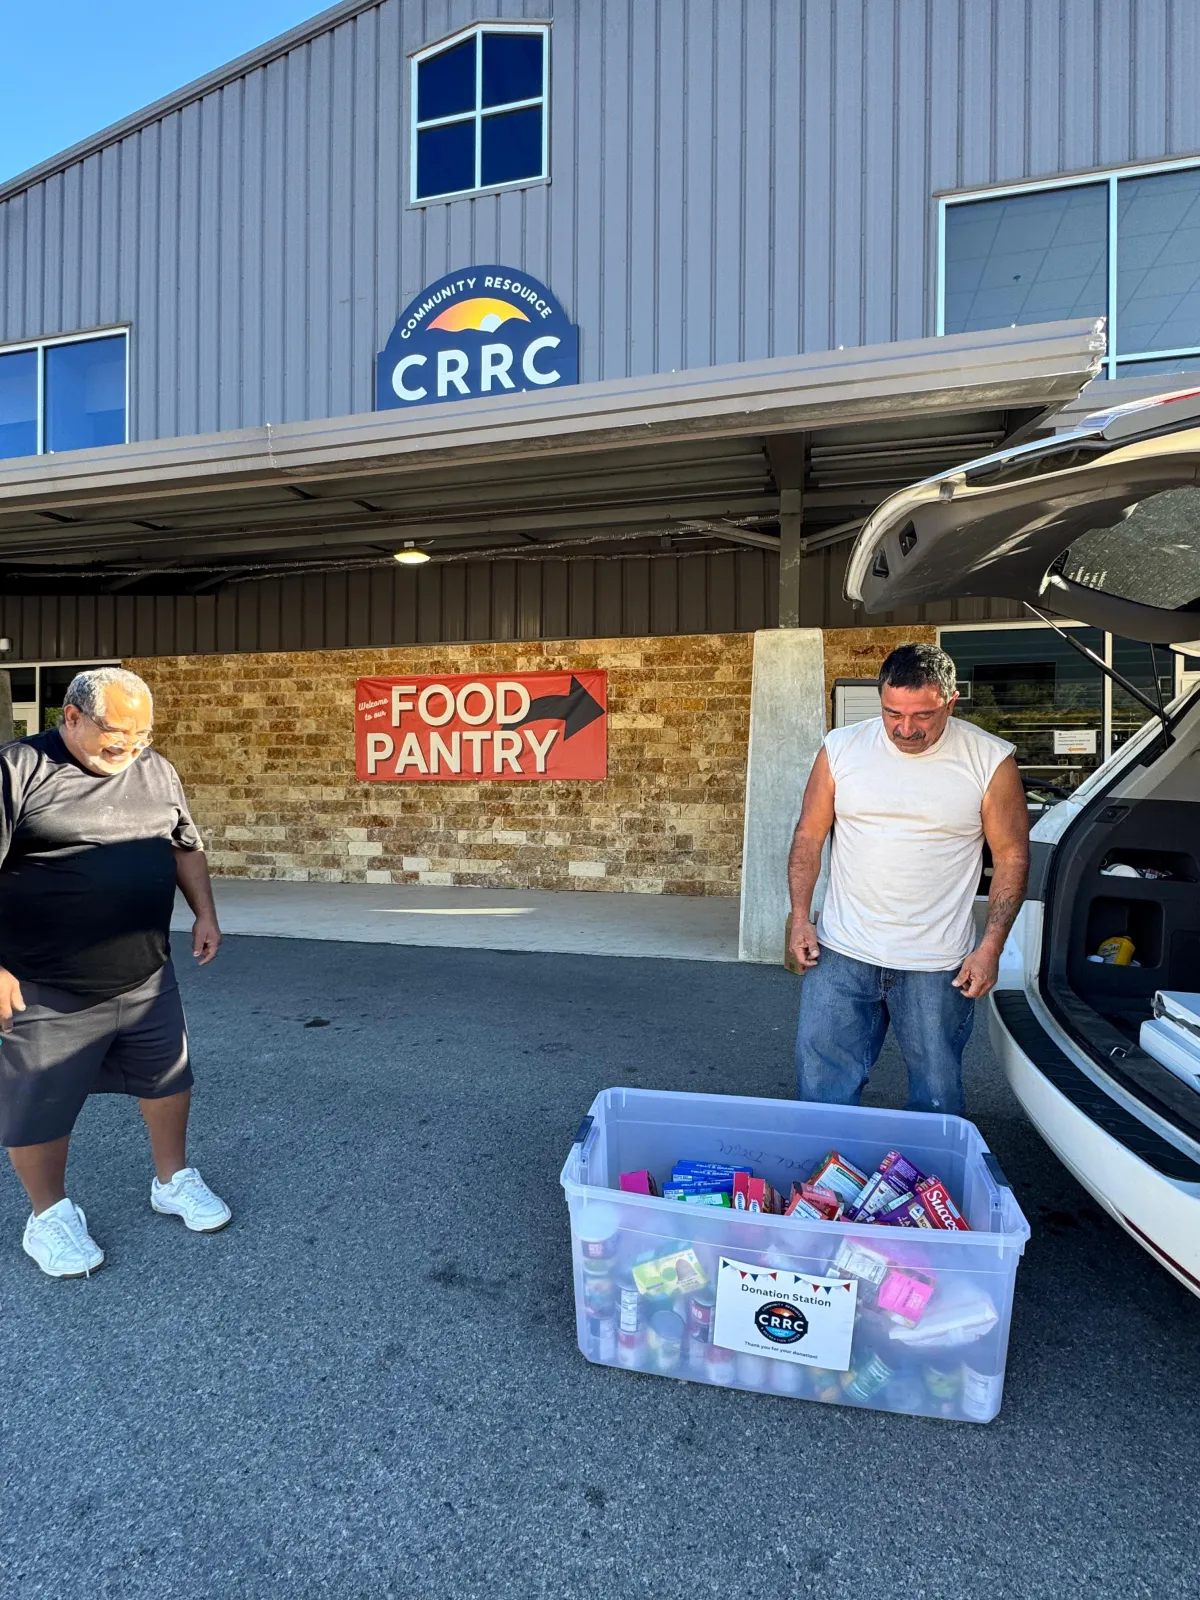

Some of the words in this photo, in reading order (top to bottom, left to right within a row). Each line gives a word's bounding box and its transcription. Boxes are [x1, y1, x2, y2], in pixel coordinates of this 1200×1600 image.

[401, 277, 477, 339] COMMUNITY
[485, 276, 552, 319] RESOURCE
[391, 335, 561, 401] CRRC
[358, 697, 389, 711] Welcome
[364, 711, 374, 721] to
[373, 710, 387, 719] our
[391, 681, 532, 728] FOOD
[366, 729, 560, 774] PANTRY
[926, 1190, 960, 1231] Succes
[741, 1283, 790, 1301] Donation
[792, 1293, 832, 1308] Station
[758, 1314, 804, 1332] CRRC
[792, 1350, 818, 1360] donation!
